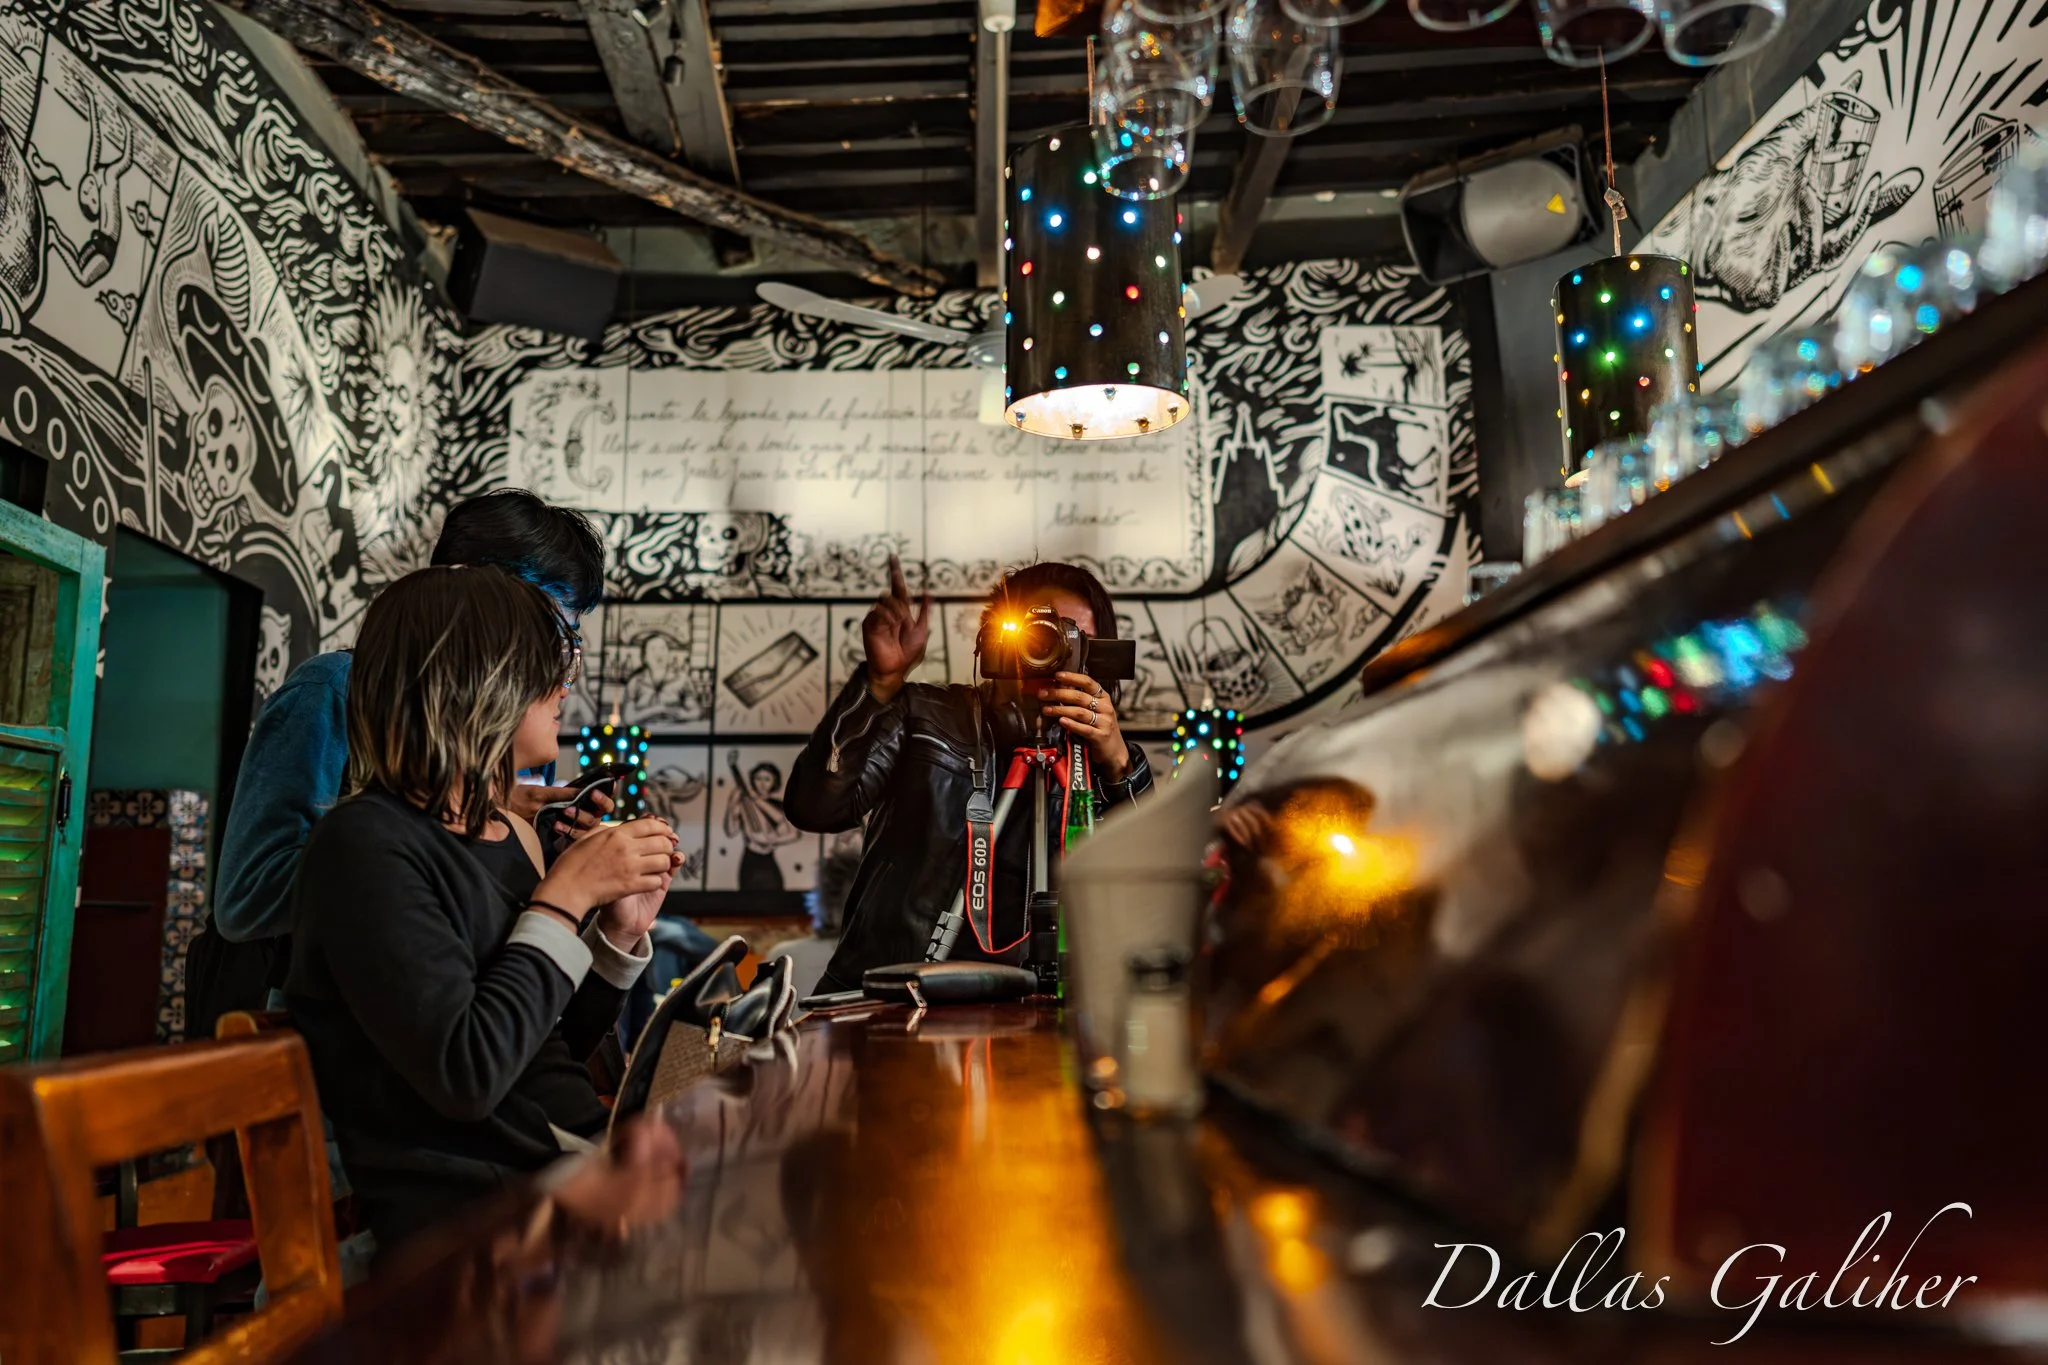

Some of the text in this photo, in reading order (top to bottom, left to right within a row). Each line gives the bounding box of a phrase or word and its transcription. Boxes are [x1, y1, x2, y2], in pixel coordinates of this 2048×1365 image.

[1072, 744, 1086, 791] Canon
[972, 837, 987, 911] EOS 60D
